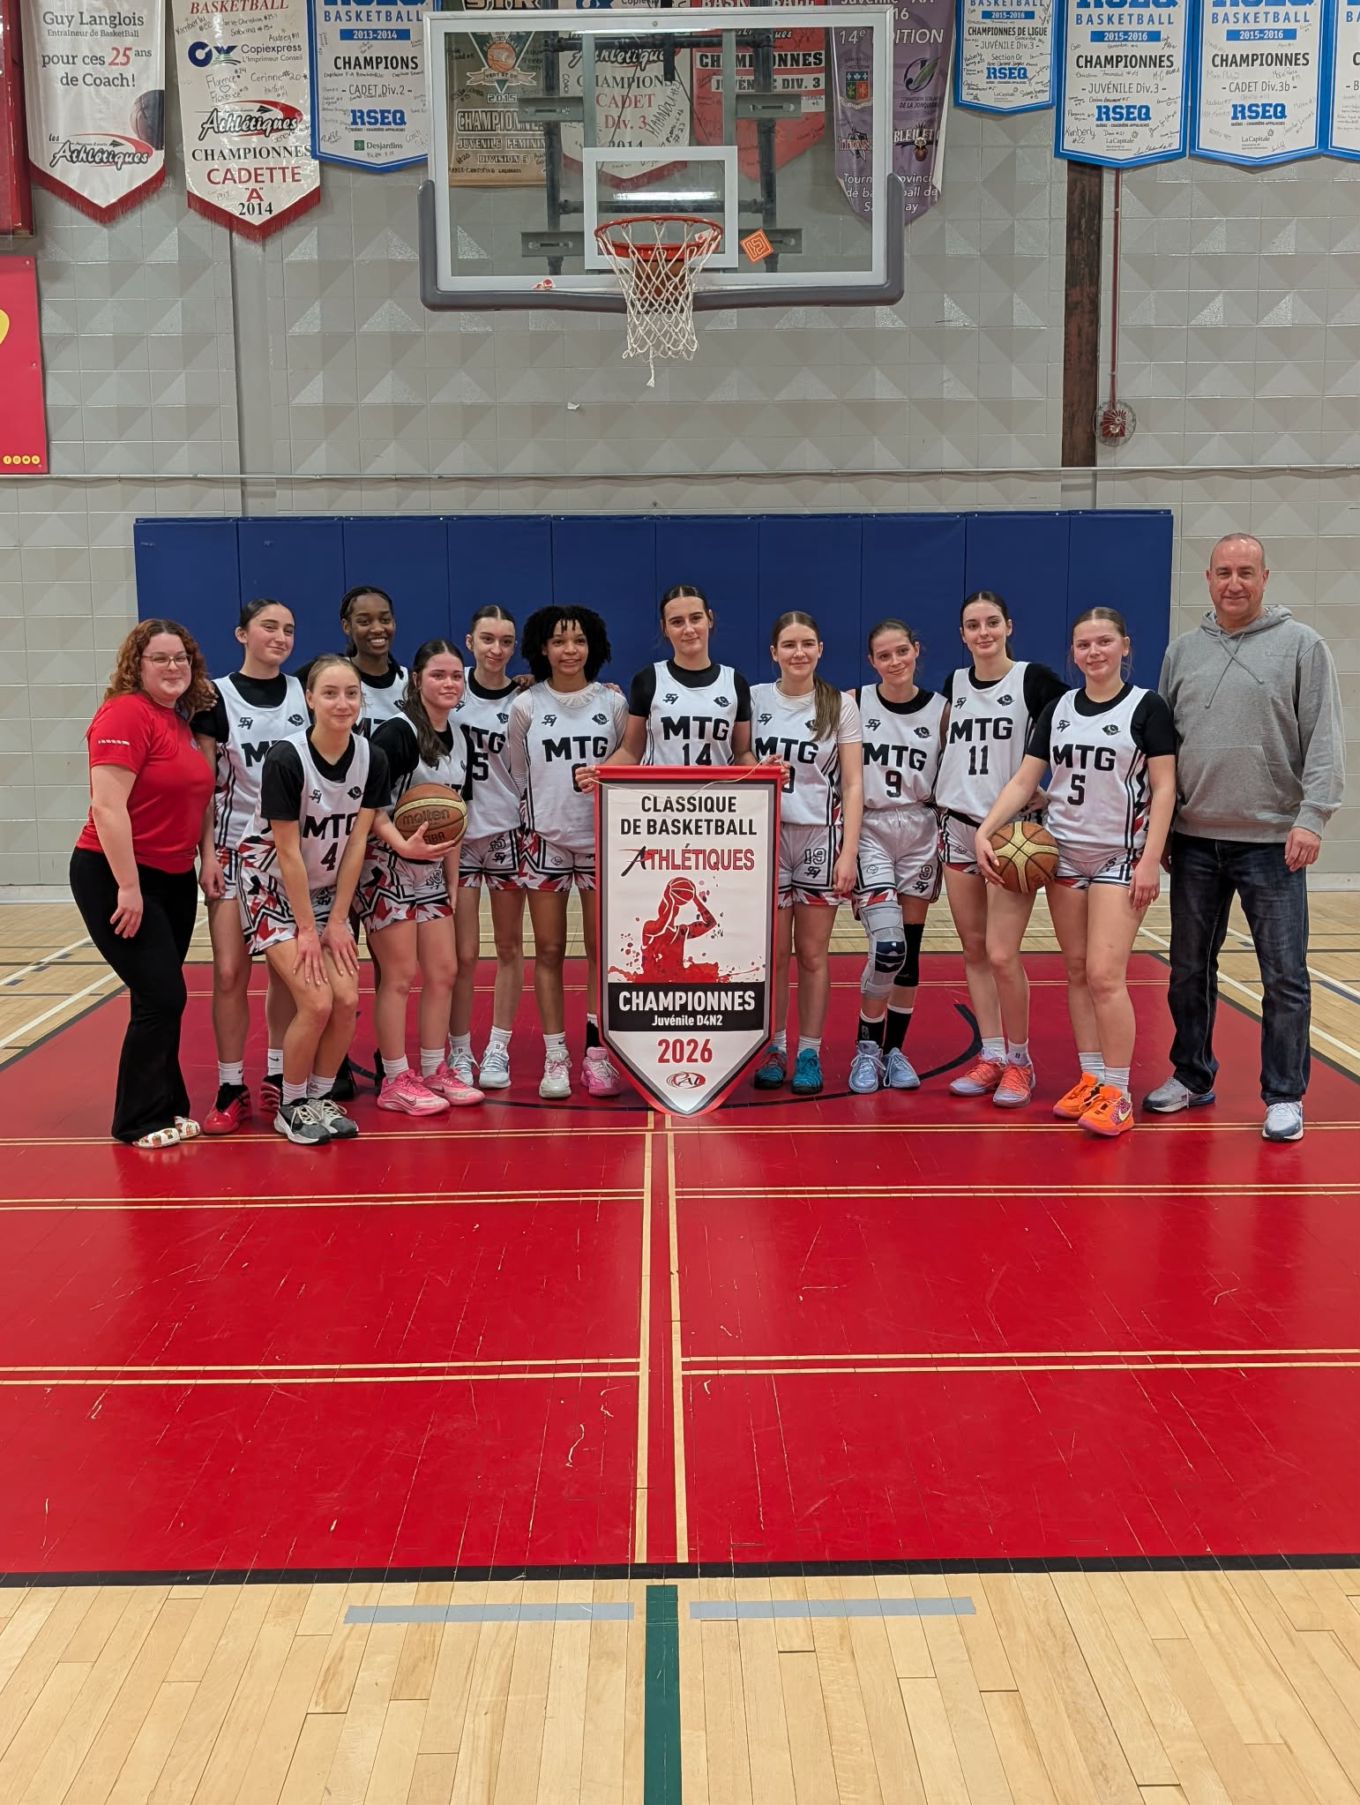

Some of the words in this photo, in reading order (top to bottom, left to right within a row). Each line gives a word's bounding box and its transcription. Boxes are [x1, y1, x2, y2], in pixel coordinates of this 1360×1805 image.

[190, 0, 289, 14] BASKETBALL
[42, 11, 75, 28] Guy
[79, 11, 144, 28] Langlois
[324, 10, 424, 22] BASKETBALL
[1076, 13, 1174, 26] BASKETBALL
[1212, 11, 1310, 24] BASKETBALL
[90, 29, 98, 37] de
[353, 30, 397, 39] 2013-2014
[893, 29, 944, 44] ITION
[968, 27, 1016, 36] CHAMPIONNES
[1017, 27, 1026, 36] DE
[1028, 27, 1047, 36] LIGUE
[1104, 32, 1148, 41] 2015-2016
[1240, 30, 1284, 39] 2015-2016
[241, 44, 302, 55] Copiexpress
[980, 41, 1014, 50] JUVÉNILE
[41, 54, 78, 68] pour
[82, 55, 106, 66] ces
[108, 47, 132, 66] 25
[134, 49, 152, 57] ans
[334, 56, 418, 70] CHAMPIONS
[1076, 54, 1174, 68] CHAMPIONNES
[1212, 52, 1310, 68] CHAMPIONNES
[60, 72, 79, 87] de
[986, 67, 1028, 80] RSEQ
[349, 84, 378, 95] CADET
[382, 84, 405, 95] Div.2
[782, 78, 808, 89] DIV.
[812, 77, 821, 88] 3
[1088, 81, 1133, 94] JUVÉNILE
[1136, 83, 1159, 93] Div.3
[1229, 82, 1258, 93] CADET
[1261, 80, 1290, 92] Div.3b
[596, 93, 655, 108] CADET
[350, 109, 407, 126] RSEQ
[1096, 104, 1152, 121] RSEQ
[1231, 103, 1287, 120] RSEQ
[199, 108, 298, 141] Athlétiques
[639, 115, 648, 129] 3
[192, 144, 312, 162] CHAMPIONNES
[366, 142, 403, 150] Desjardins
[207, 166, 302, 185] CADETTE
[844, 173, 872, 184] Tourn
[847, 189, 859, 198] de
[238, 202, 273, 216] 2014
[661, 716, 730, 741] MTG
[949, 717, 1013, 744] MTG
[460, 724, 506, 754] TG
[542, 736, 608, 762] MTG
[682, 743, 712, 766] 14
[754, 736, 819, 764] MTG
[862, 742, 928, 772] MTG
[968, 745, 989, 775] 11
[1052, 744, 1116, 771] MTG
[885, 770, 902, 798] 9
[1067, 774, 1086, 806] 5
[641, 796, 736, 813] CLASSIQUE
[620, 819, 642, 835] DE
[647, 819, 757, 835] BASKETBALL
[320, 842, 338, 871] 4
[804, 848, 826, 865] 19
[618, 991, 755, 1011] CHAMPIONNES
[652, 1014, 694, 1026] Juvénile
[696, 1015, 723, 1026] D4N2
[657, 1038, 713, 1064] 2026
